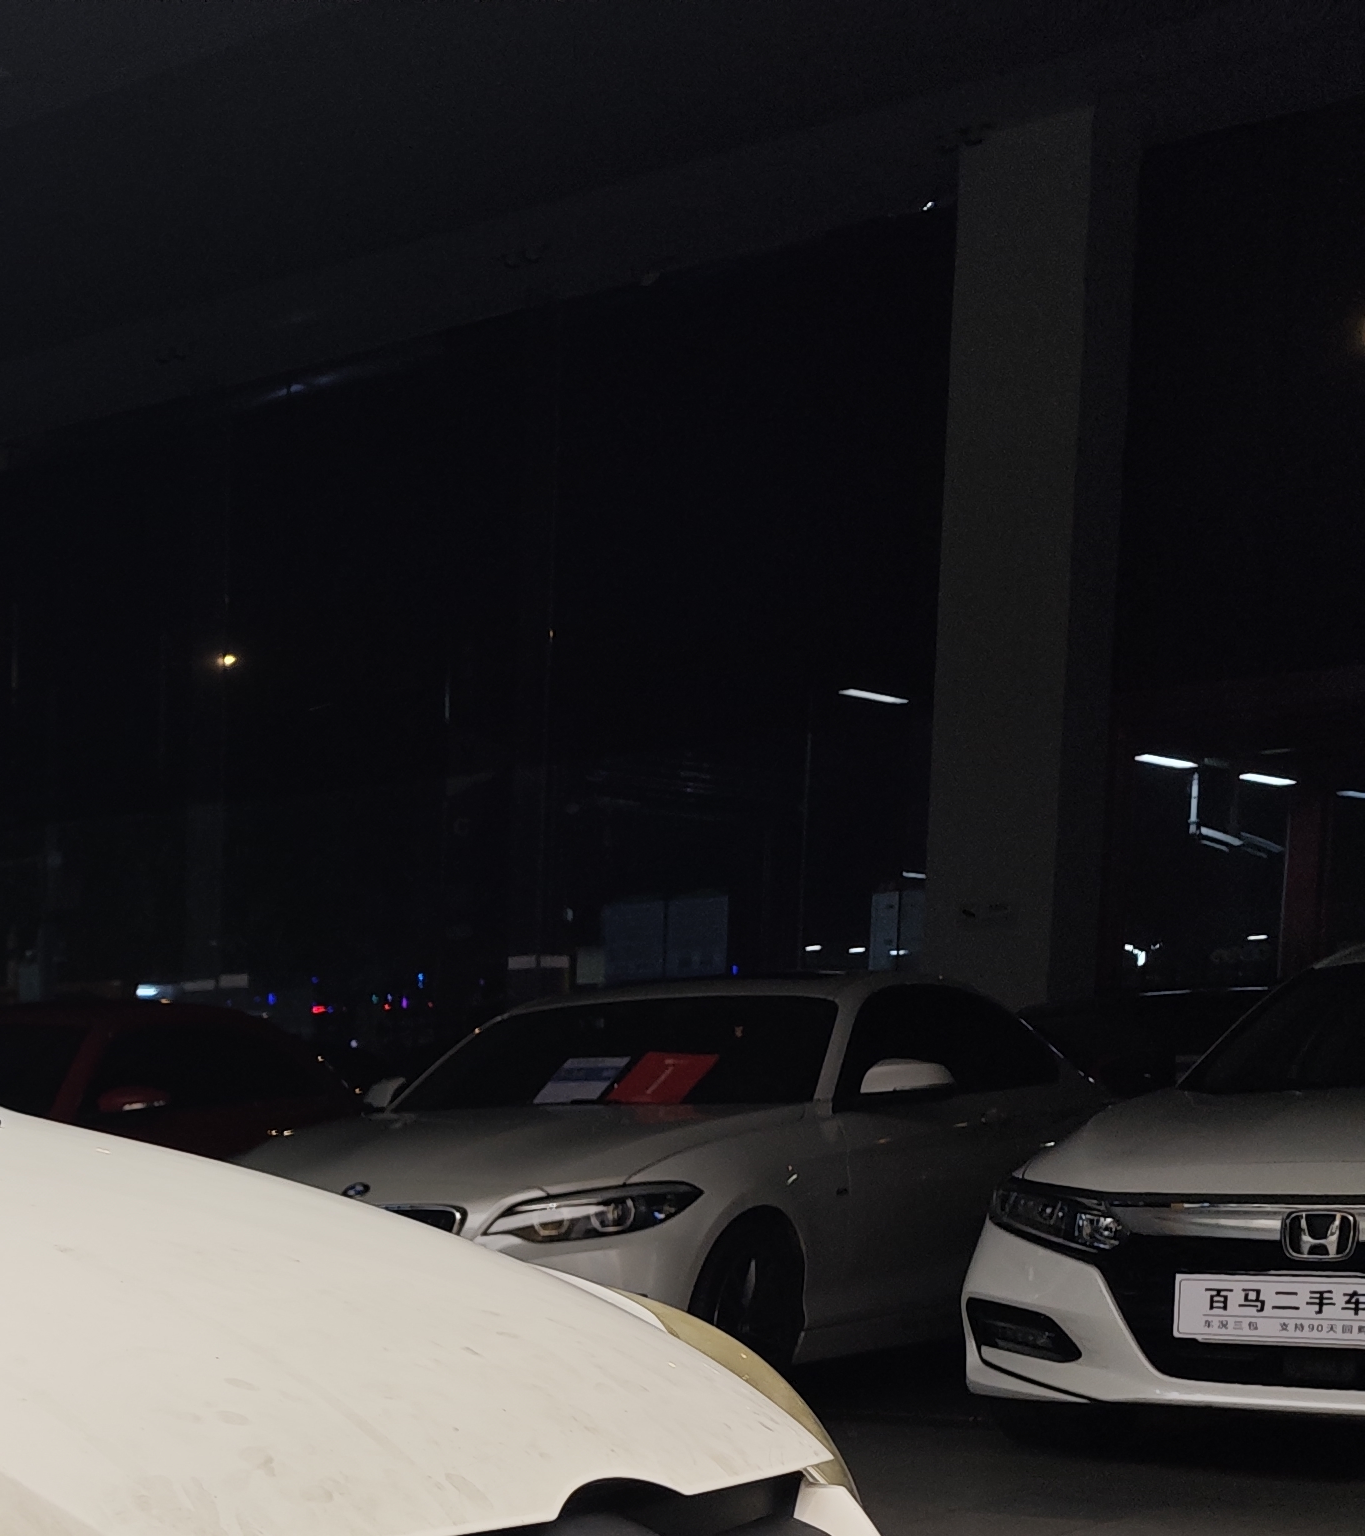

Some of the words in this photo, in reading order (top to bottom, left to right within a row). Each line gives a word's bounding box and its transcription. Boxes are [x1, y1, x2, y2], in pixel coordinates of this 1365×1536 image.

[1204, 1287, 1365, 1317] 百马二手车
